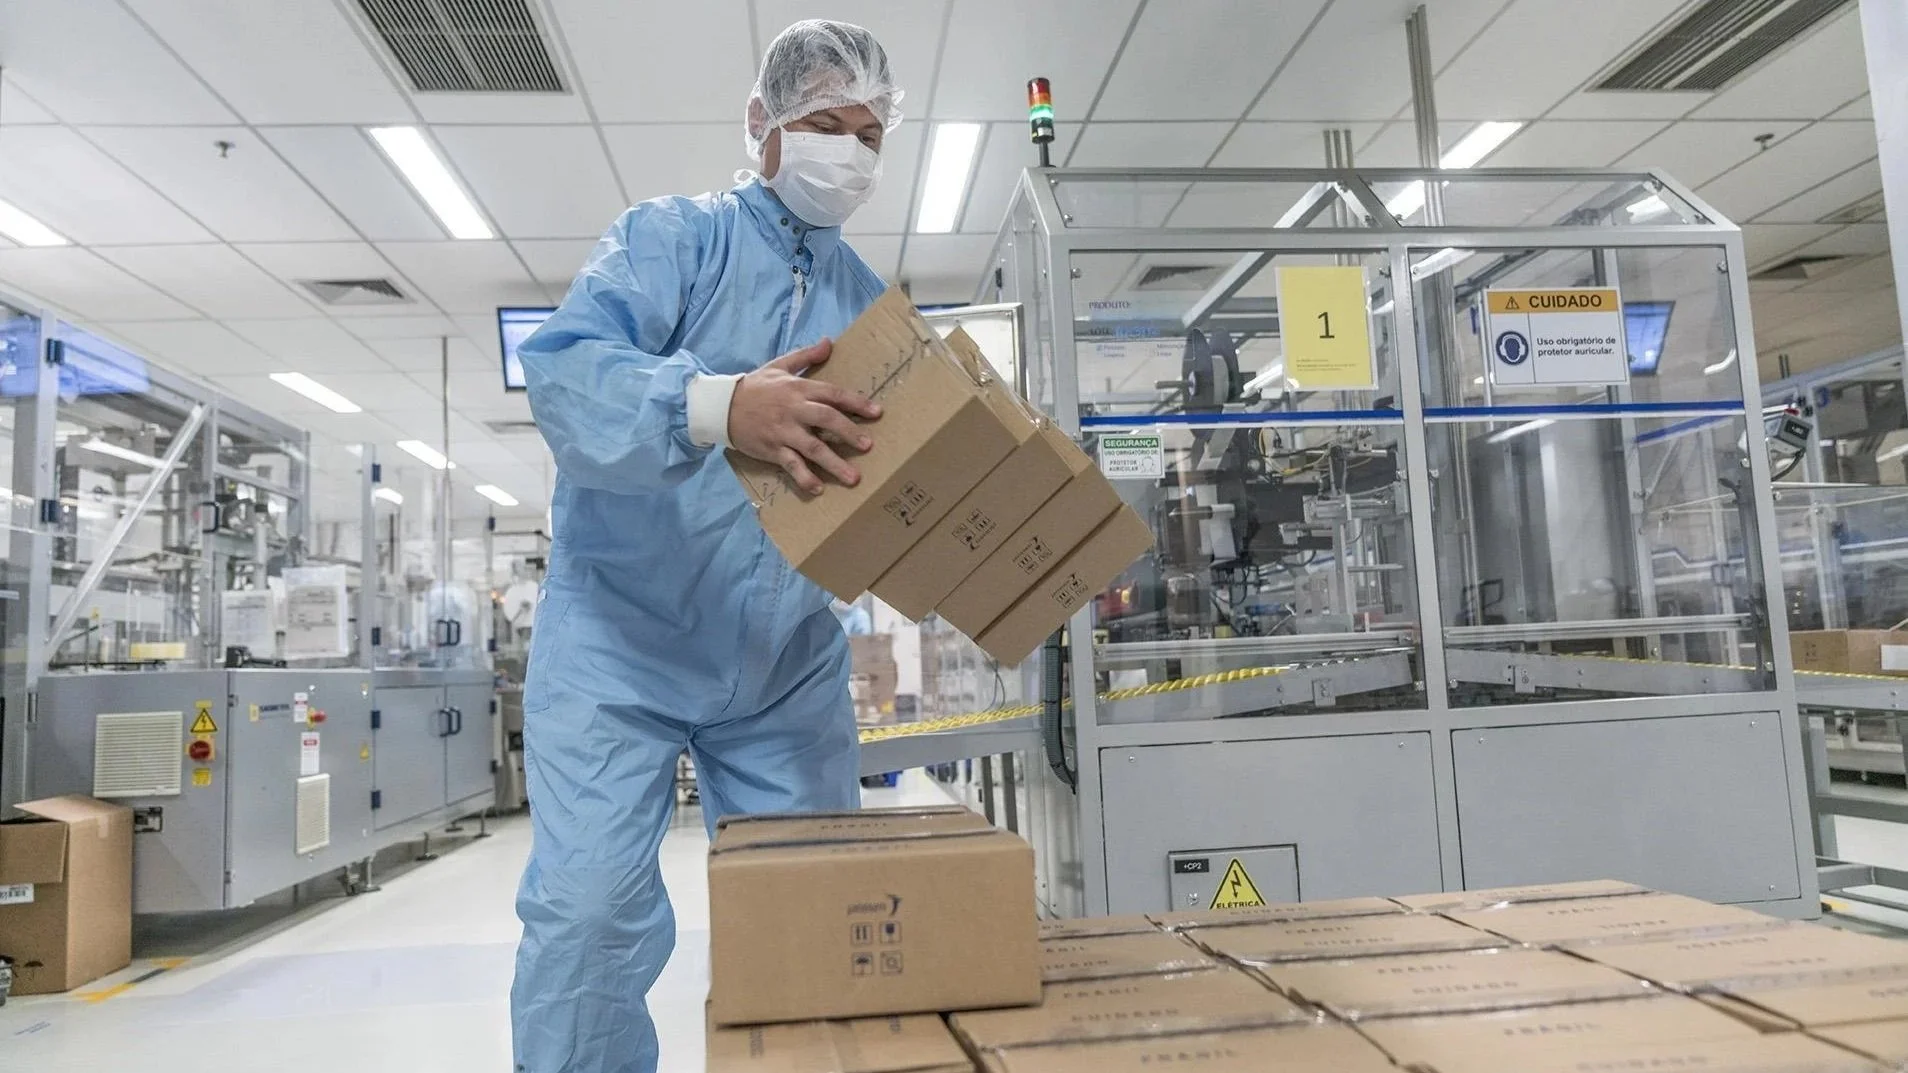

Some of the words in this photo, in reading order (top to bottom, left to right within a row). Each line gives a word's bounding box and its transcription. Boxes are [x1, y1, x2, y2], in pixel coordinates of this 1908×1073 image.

[1529, 294, 1602, 309] CUIDADO
[1317, 311, 1335, 339] 1
[1536, 338, 1554, 346] Uso
[1556, 337, 1603, 347] obrigatório
[1605, 336, 1616, 344] de
[1537, 348, 1573, 357] protetor
[1574, 347, 1615, 356] auricular.
[1104, 439, 1158, 449] SEGURANÇA
[1184, 862, 1202, 870] +CP2
[1216, 900, 1260, 910] ELÉTRICA
